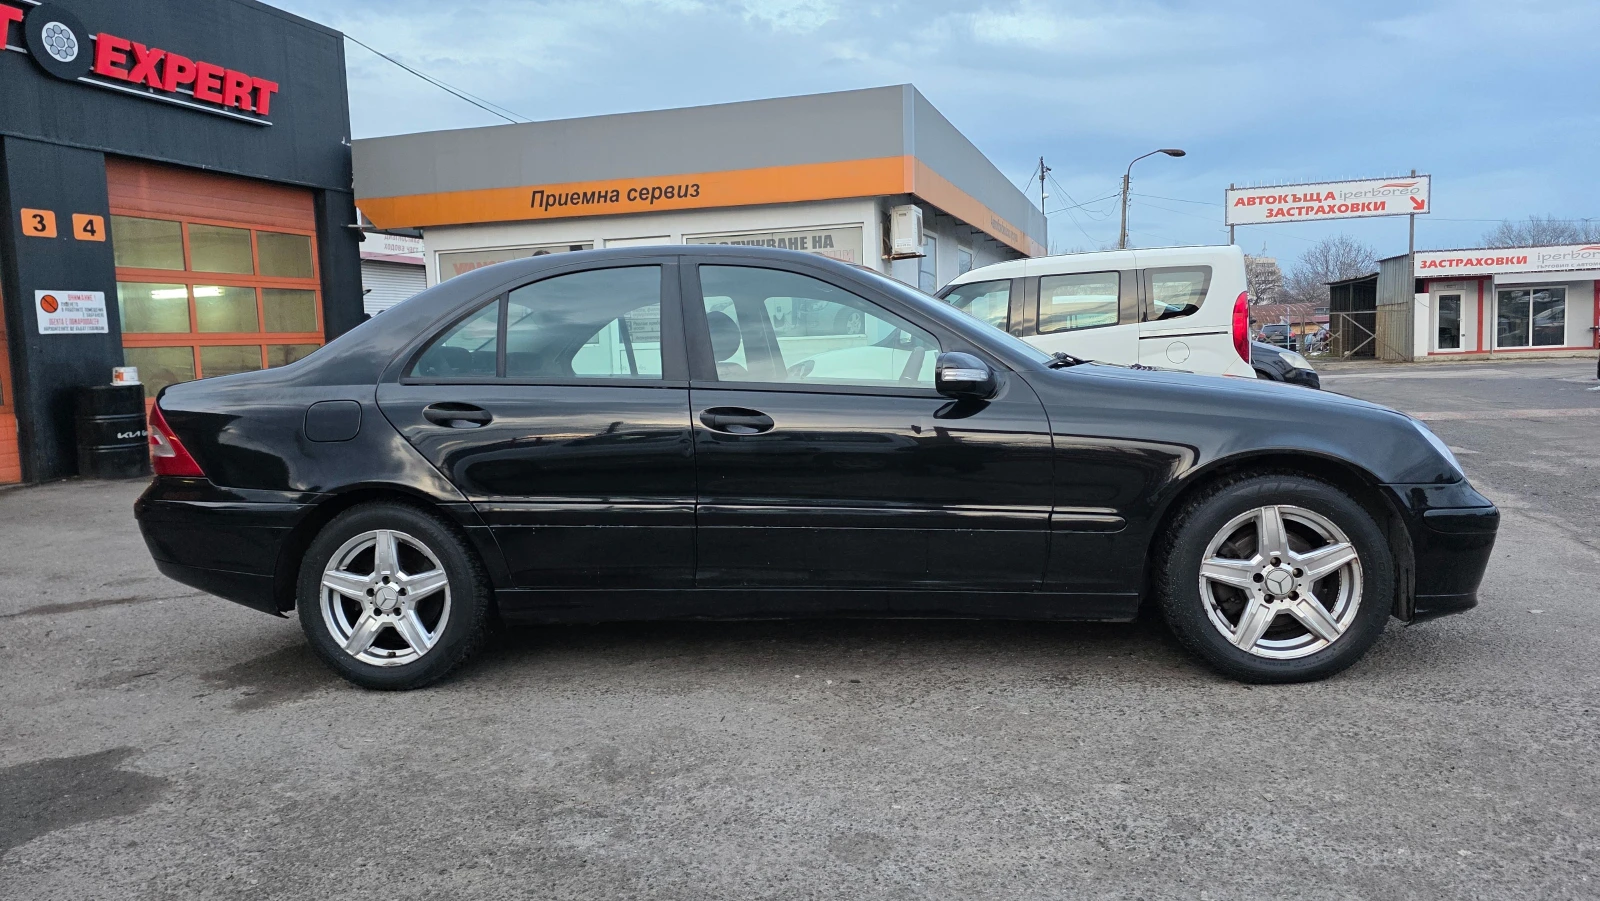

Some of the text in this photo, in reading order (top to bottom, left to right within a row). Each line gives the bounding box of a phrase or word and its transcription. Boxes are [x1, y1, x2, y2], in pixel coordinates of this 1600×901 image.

[93, 32, 279, 116] EXPERT
[530, 183, 700, 211] Приемна сервиз
[1234, 186, 1420, 207] АВТОКЪЩА iperboreo
[1265, 201, 1386, 218] ЗАСТРАХОВКИ
[32, 213, 46, 232] 3
[83, 219, 96, 236] 4
[812, 234, 834, 249] НА
[1419, 255, 1528, 269] ЗАСТРАХОВКИ
